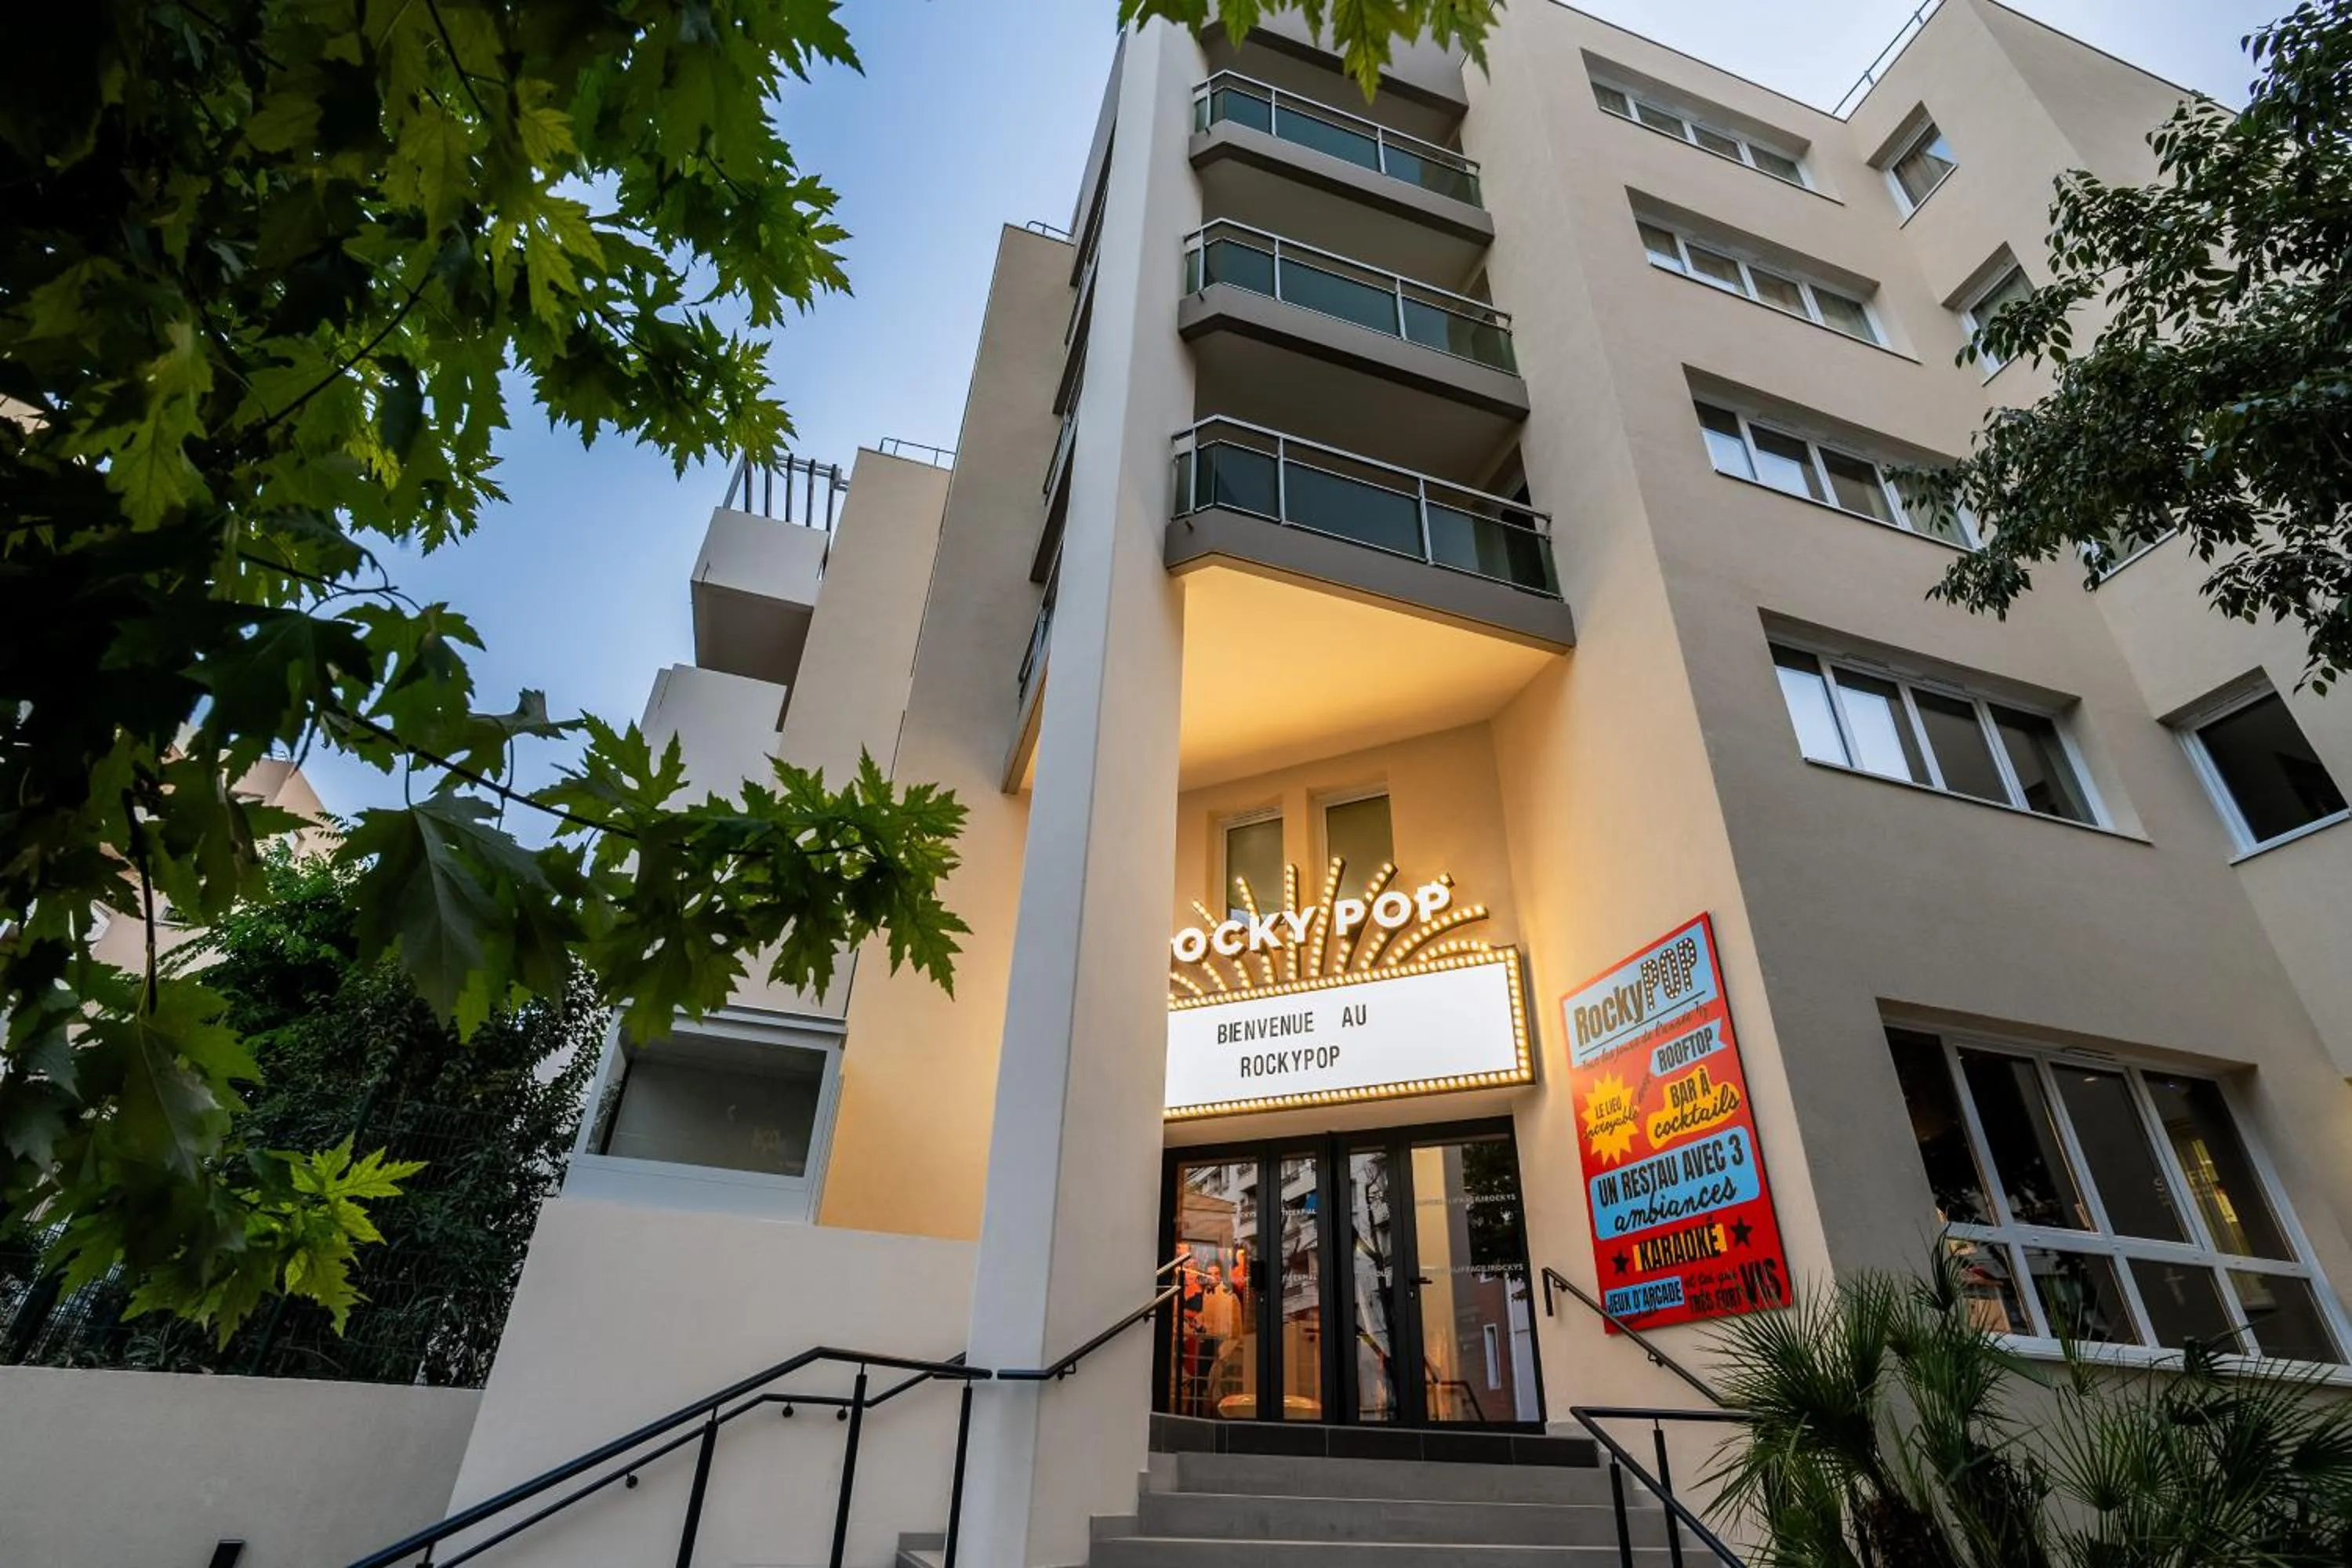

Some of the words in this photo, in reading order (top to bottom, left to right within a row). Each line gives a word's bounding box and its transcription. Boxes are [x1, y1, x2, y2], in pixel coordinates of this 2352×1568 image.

[1173, 906, 1316, 963] OCKY
[1335, 883, 1452, 936] POP
[1218, 1011, 1314, 1044] BIENVENUE
[1341, 1004, 1367, 1028] AU
[1240, 1045, 1340, 1078] ROCKYPOP
[1657, 1027, 1713, 1073] ROOFTOP
[1595, 1103, 1606, 1120] LE
[1606, 1095, 1623, 1116] LIEU
[1654, 1083, 1740, 1138] cocktails
[1669, 1078, 1697, 1108] BAR
[1698, 1067, 1711, 1098] À
[1584, 1105, 1639, 1139] incroyable
[1598, 1176, 1619, 1207] UN
[1621, 1156, 1679, 1200] RESTAU
[1682, 1139, 1726, 1181] AVEC
[1728, 1134, 1744, 1166] 3
[1615, 1176, 1737, 1232] ambiances
[1639, 1216, 1722, 1272] KARAOKÉ
[1608, 1290, 1632, 1314] JEUX
[1632, 1280, 1682, 1309] D'ARCADE
[1739, 1258, 1782, 1305] VIS
